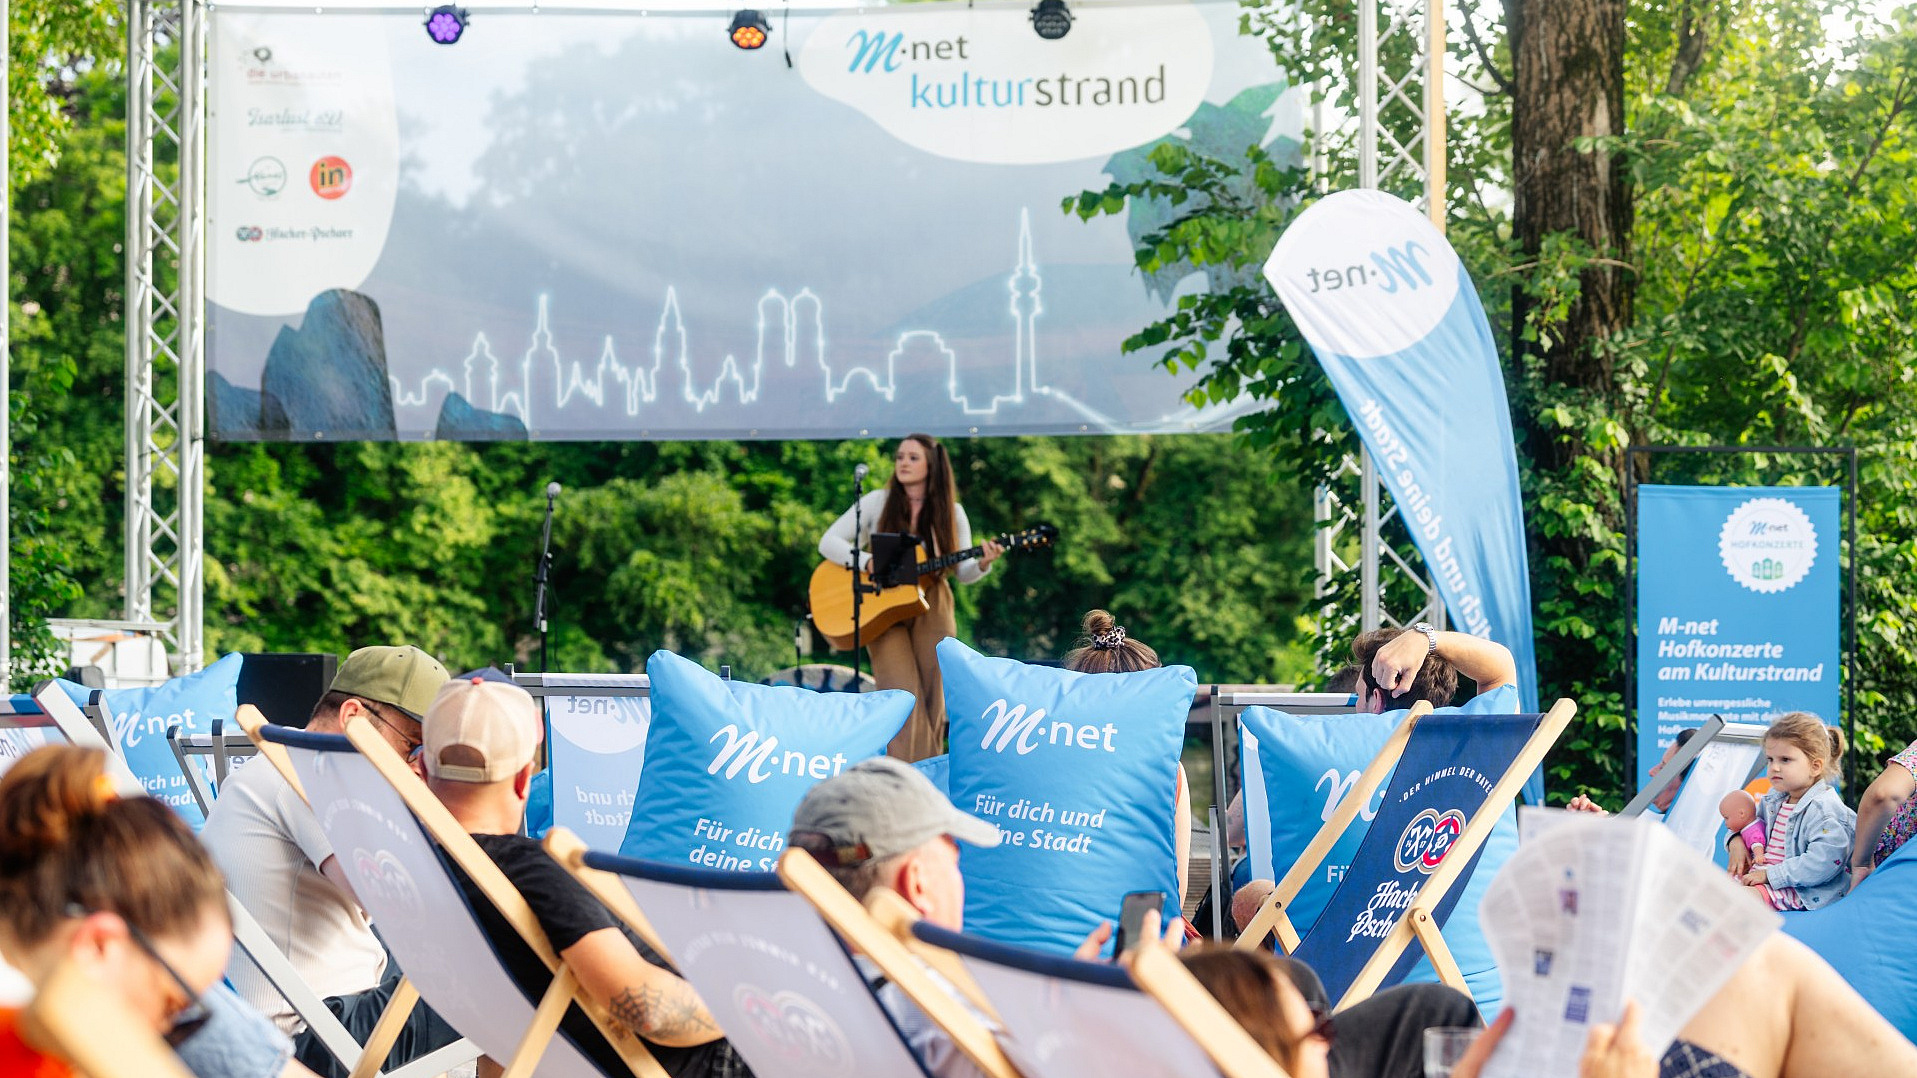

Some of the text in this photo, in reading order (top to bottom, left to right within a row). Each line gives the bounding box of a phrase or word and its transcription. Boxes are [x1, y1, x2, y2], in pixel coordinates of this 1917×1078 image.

[911, 64, 1166, 108] kulturstrand
[320, 162, 344, 187] in
[1731, 540, 1804, 549] HOFKONZERTE
[1658, 617, 1719, 635] M-net
[1658, 639, 1784, 659] Hofkonzerte
[1658, 662, 1824, 682] am Kulturstrand
[1657, 697, 1772, 710] Erlebe unvergessliche
[1403, 766, 1494, 802] DER HIMMEL DER BAYE
[975, 794, 1106, 829] Für dich und
[694, 818, 784, 852] Für dich
[996, 824, 1092, 854] ine Stadt
[689, 845, 752, 873] deine
[1368, 880, 1419, 911] Hack
[1345, 910, 1397, 944] Psch
